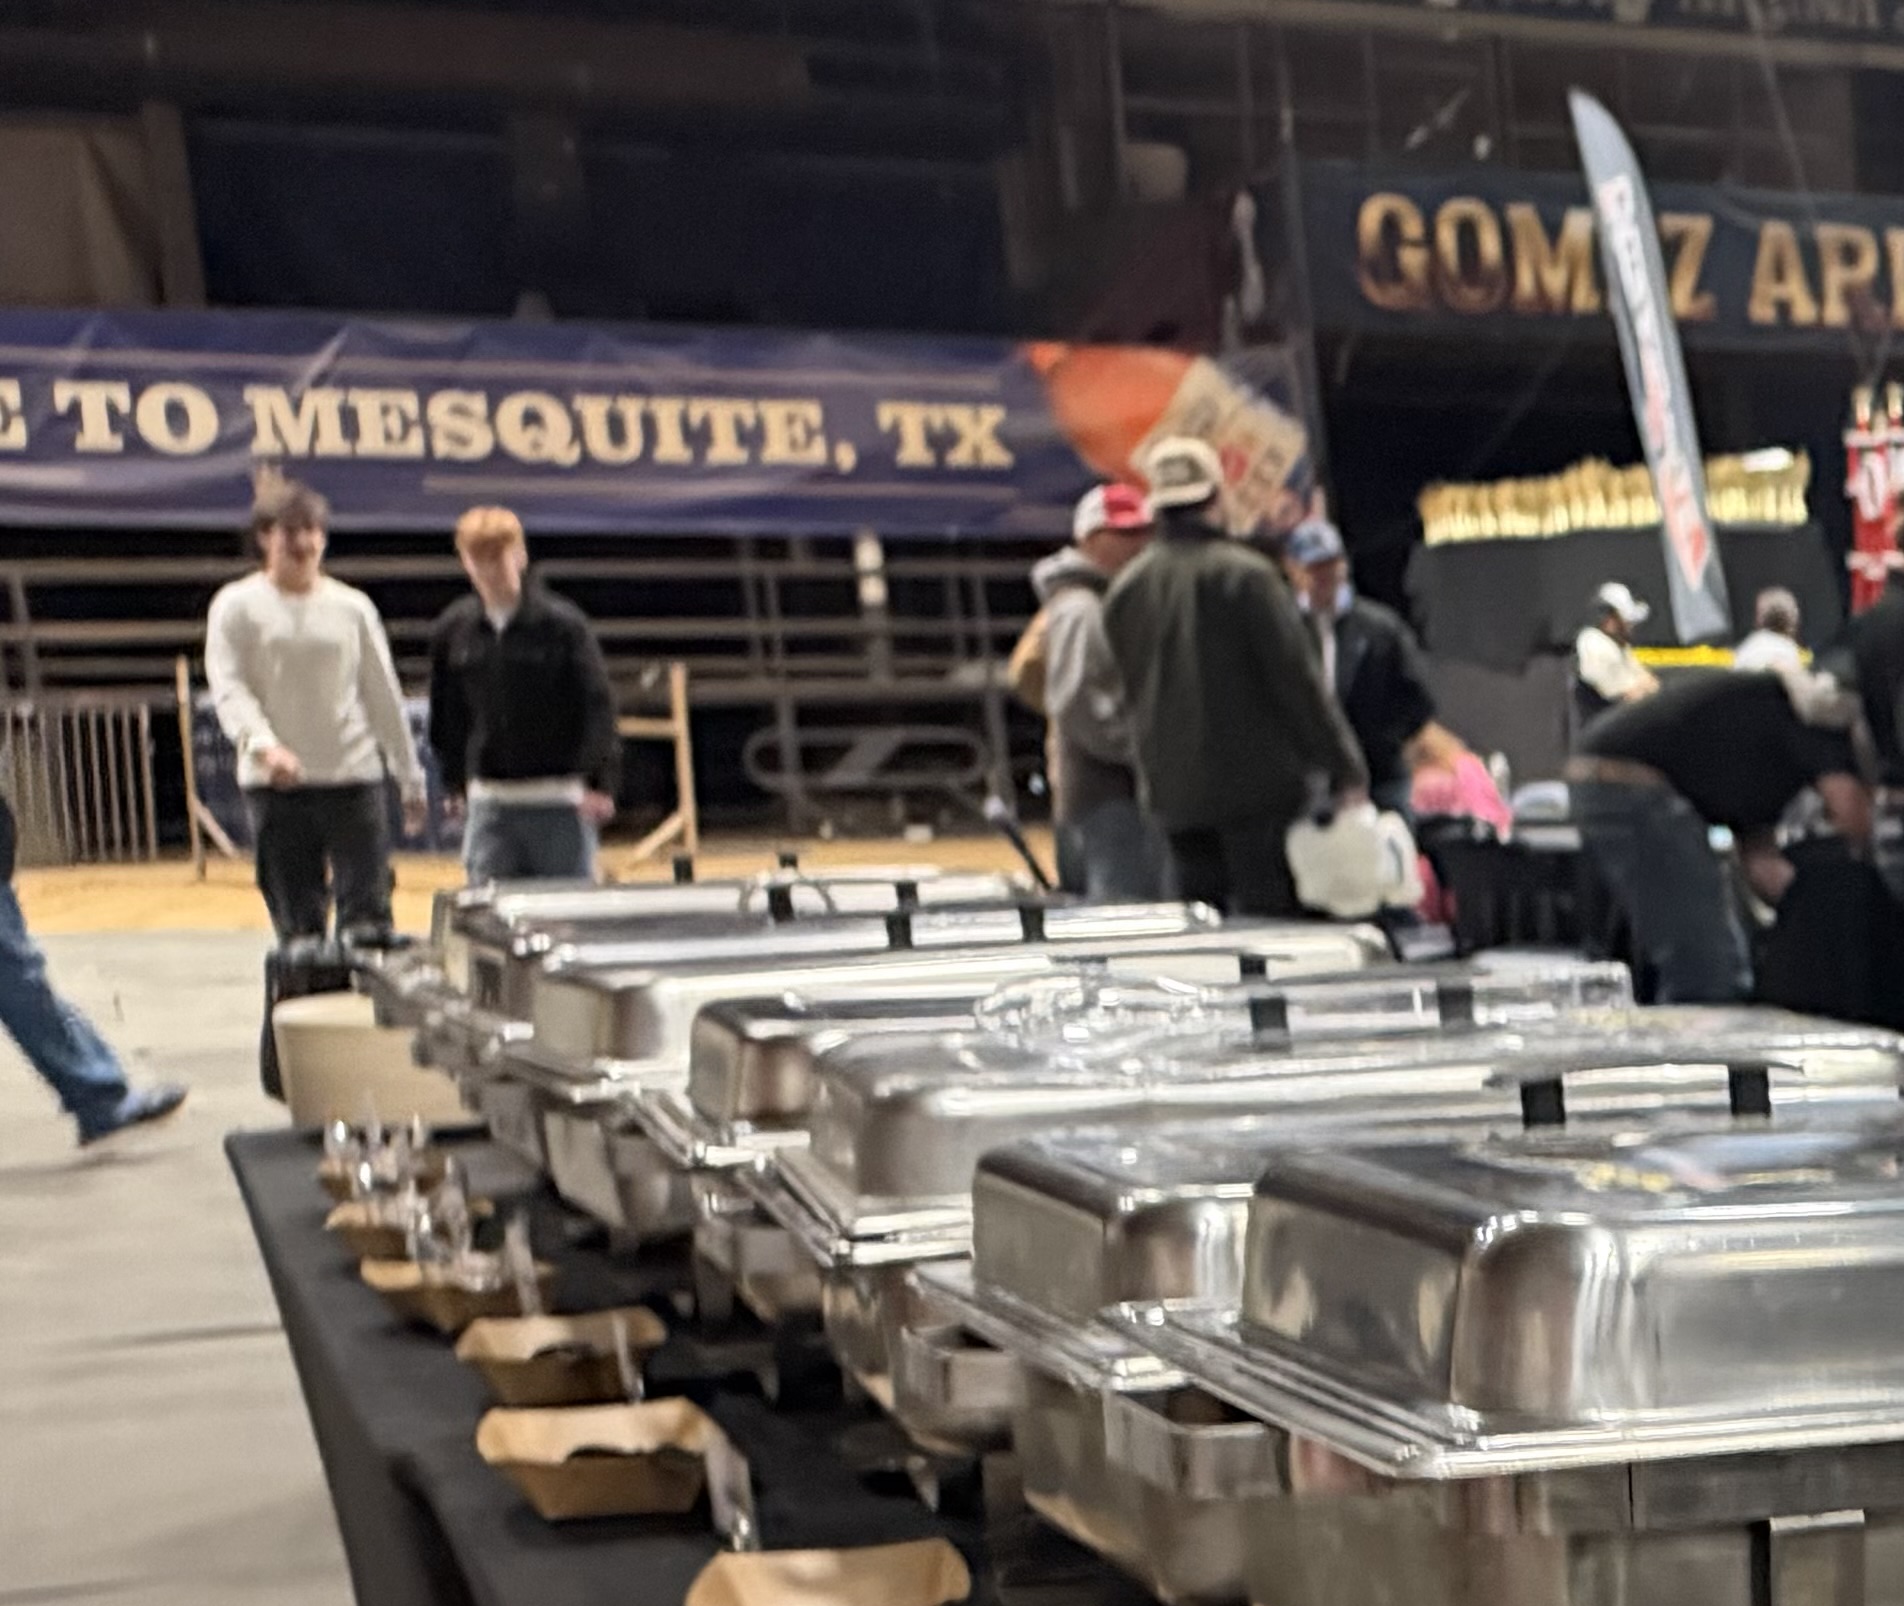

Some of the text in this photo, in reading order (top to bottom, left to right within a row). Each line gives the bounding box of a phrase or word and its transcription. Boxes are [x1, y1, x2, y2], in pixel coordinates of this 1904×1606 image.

[1356, 192, 1718, 322] GOMZ
[53, 378, 220, 456] TO
[242, 383, 857, 475] MESQUITE,
[876, 402, 1015, 470] TX
